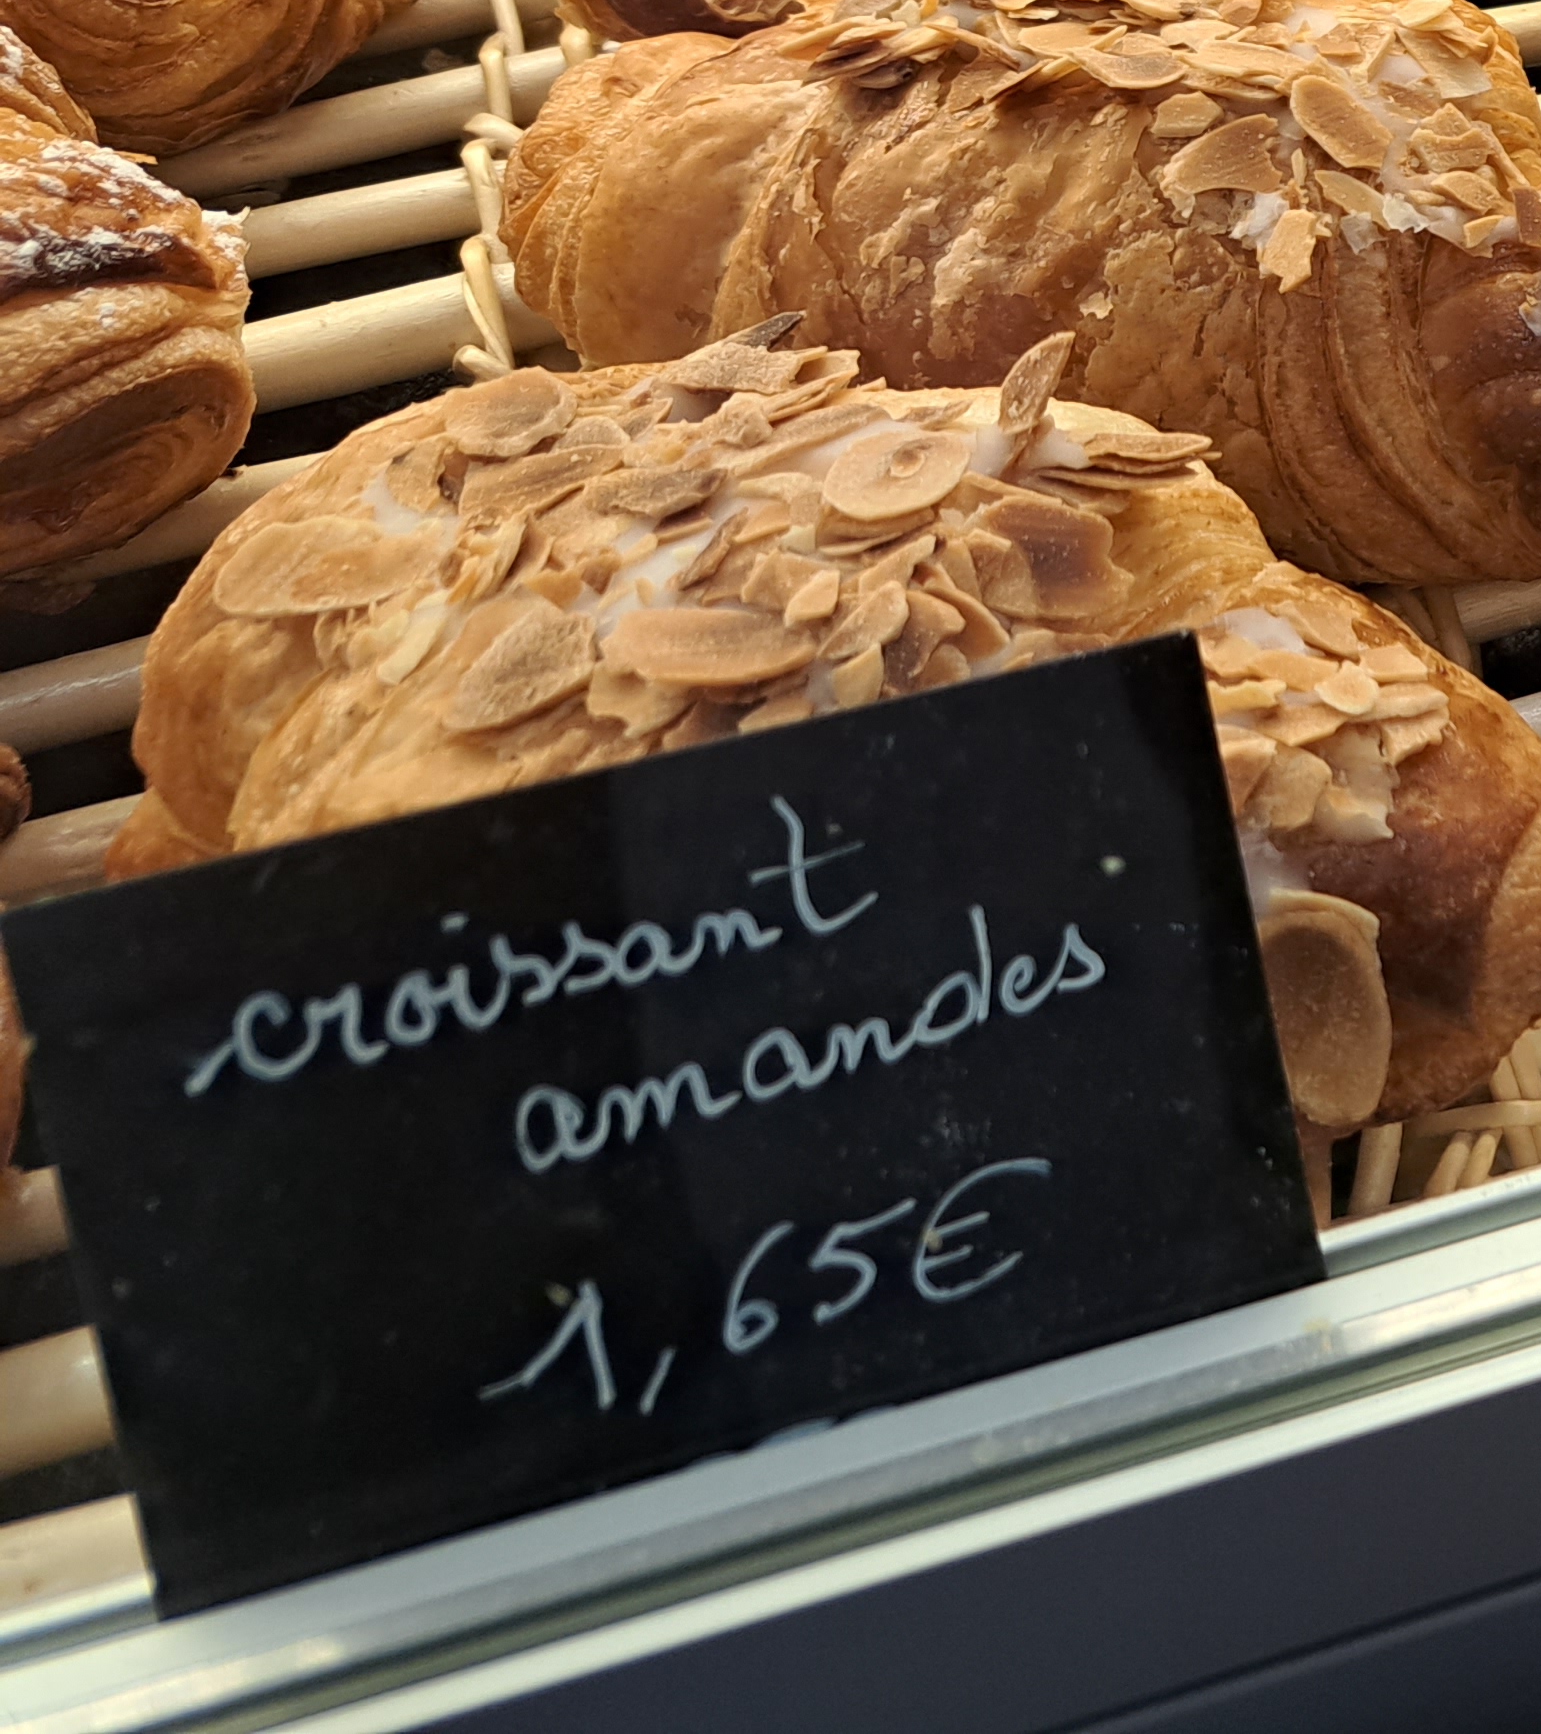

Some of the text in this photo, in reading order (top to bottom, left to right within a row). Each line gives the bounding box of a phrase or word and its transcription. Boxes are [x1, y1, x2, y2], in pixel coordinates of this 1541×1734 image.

[185, 794, 878, 1098] croissant
[516, 906, 1106, 1172] amandes
[478, 1156, 1052, 1416] 1,65€
